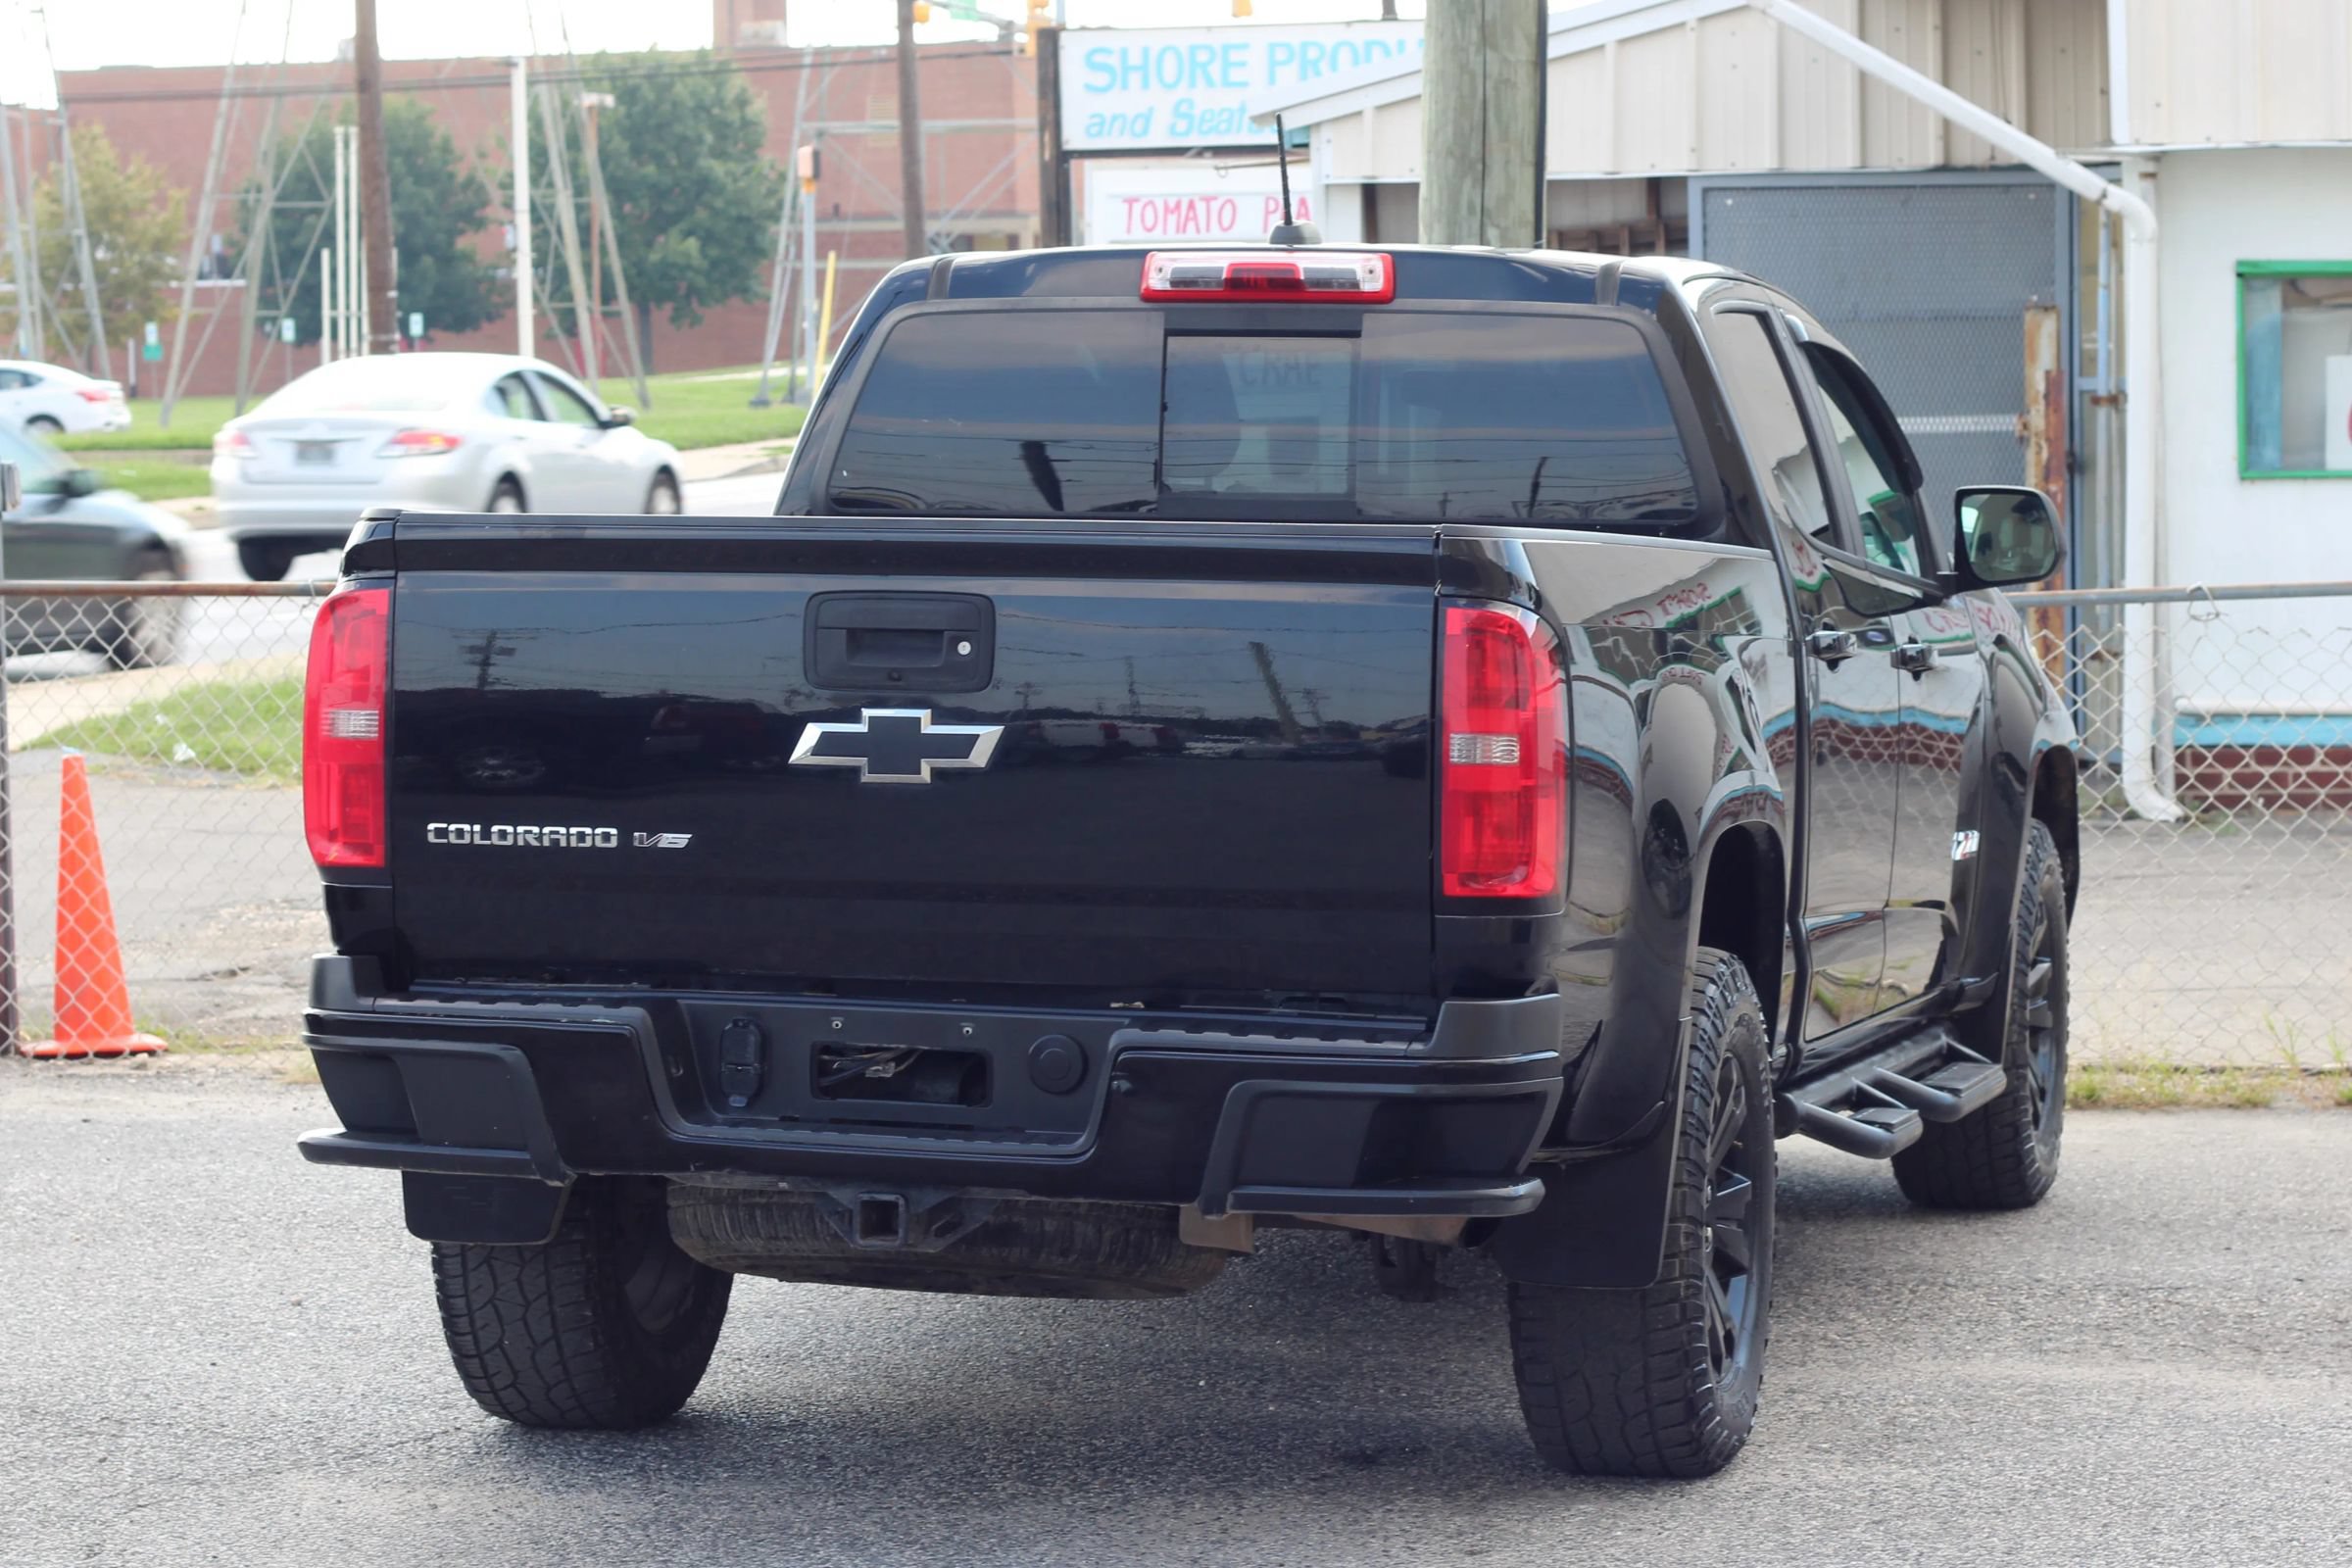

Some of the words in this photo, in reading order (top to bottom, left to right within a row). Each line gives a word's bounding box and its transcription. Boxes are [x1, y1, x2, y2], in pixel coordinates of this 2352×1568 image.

[1082, 43, 1250, 93] SHORE
[1267, 39, 1423, 85] PROD
[1084, 106, 1154, 139] and
[1123, 196, 1238, 235] TOMATO
[427, 823, 617, 848] COLORADO
[633, 832, 692, 849] V6
